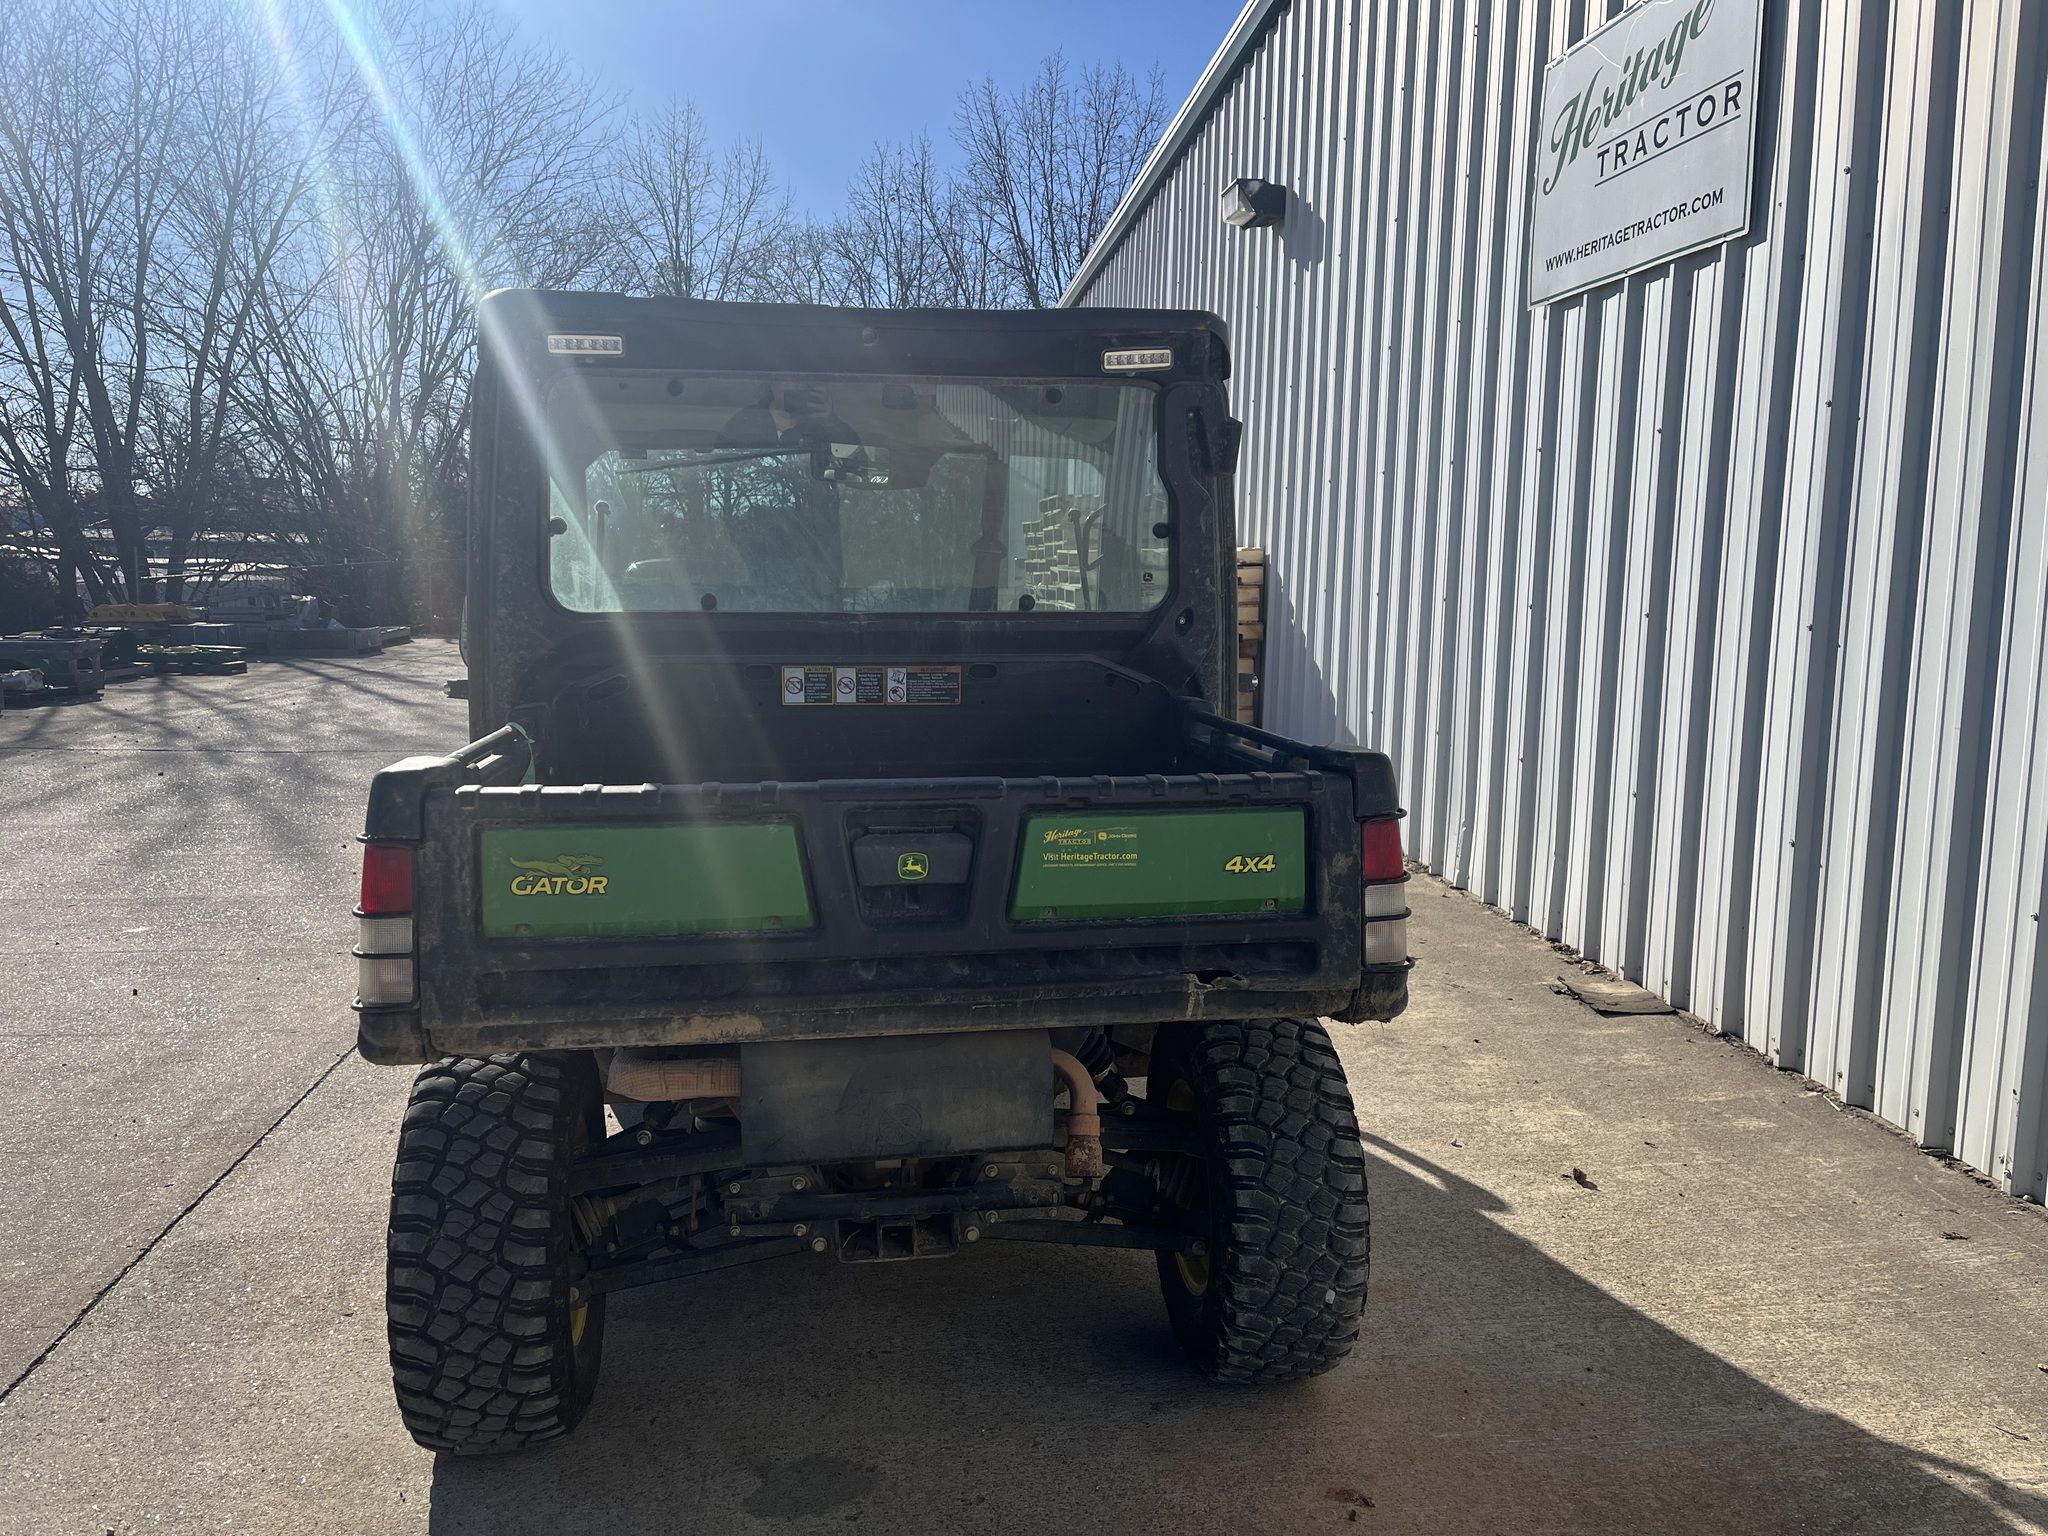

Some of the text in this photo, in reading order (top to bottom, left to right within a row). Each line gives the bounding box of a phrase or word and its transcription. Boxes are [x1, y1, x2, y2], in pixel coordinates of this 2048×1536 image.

[1543, 0, 1715, 195] Heritage
[1596, 80, 1742, 178] TRACTOR
[1545, 187, 1724, 272] WWW.HERITAGETRACTOR.COM
[510, 876, 609, 896] GATOR
[1043, 852, 1138, 862] Visit HeritageTractor.com
